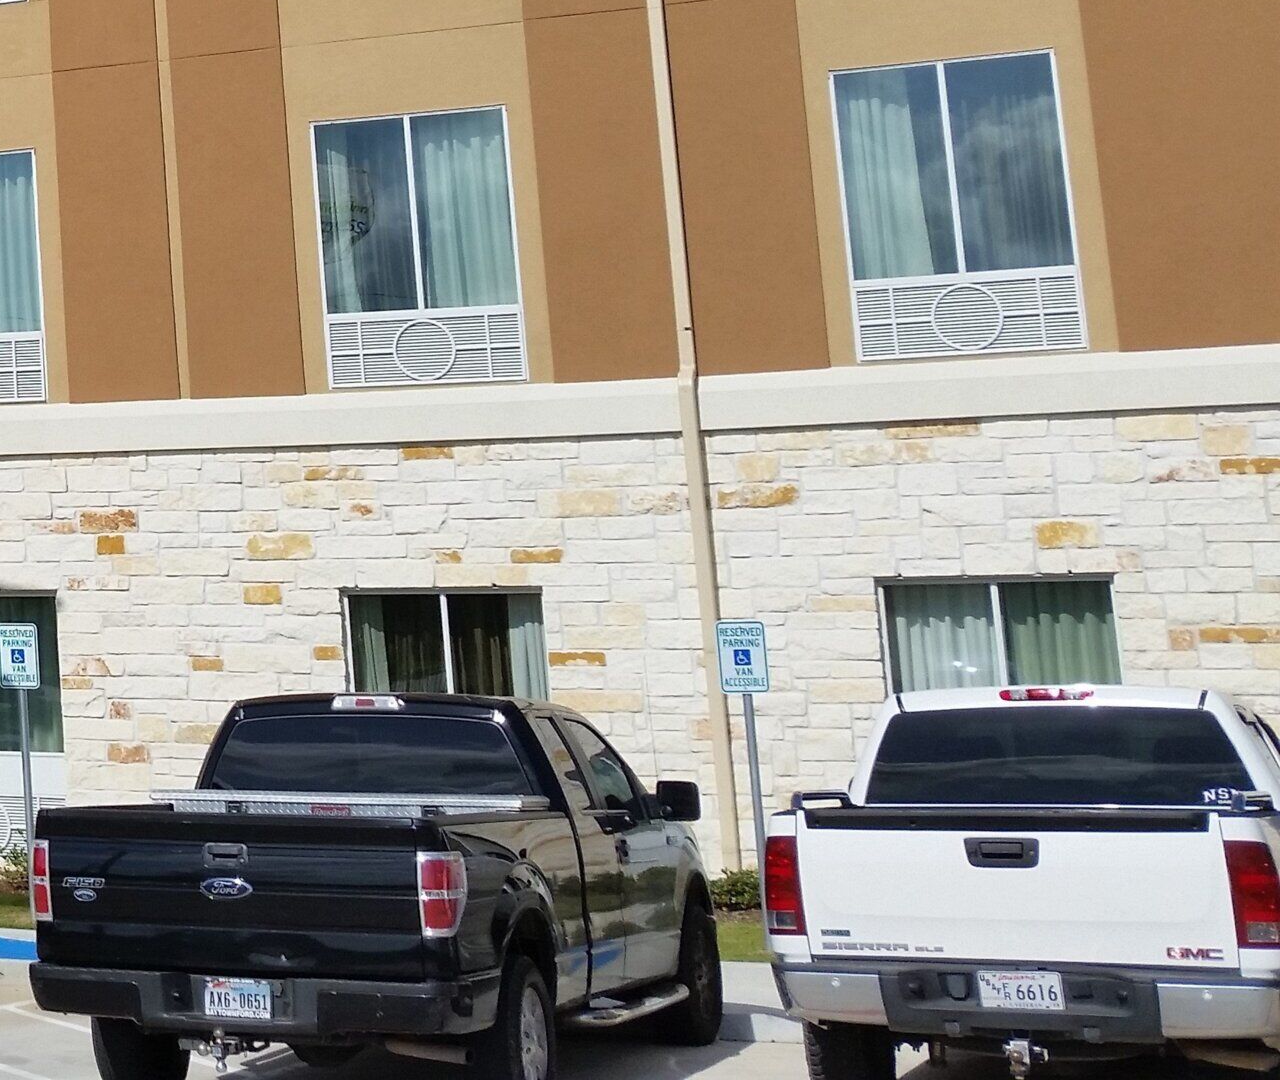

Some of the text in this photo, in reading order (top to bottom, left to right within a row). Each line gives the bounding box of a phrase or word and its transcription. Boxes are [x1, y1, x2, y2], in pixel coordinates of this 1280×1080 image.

[0, 629, 34, 638] RESERVED
[719, 627, 761, 637] RESERVED
[2, 639, 32, 648] PARKING
[722, 638, 760, 648] PARKING
[12, 665, 27, 673] VAN
[734, 667, 753, 676] VAN
[724, 677, 766, 687] ACCESSIBLE
[211, 881, 239, 895] Ford
[1166, 947, 1224, 960] GMC
[1016, 984, 1058, 1002] 6616
